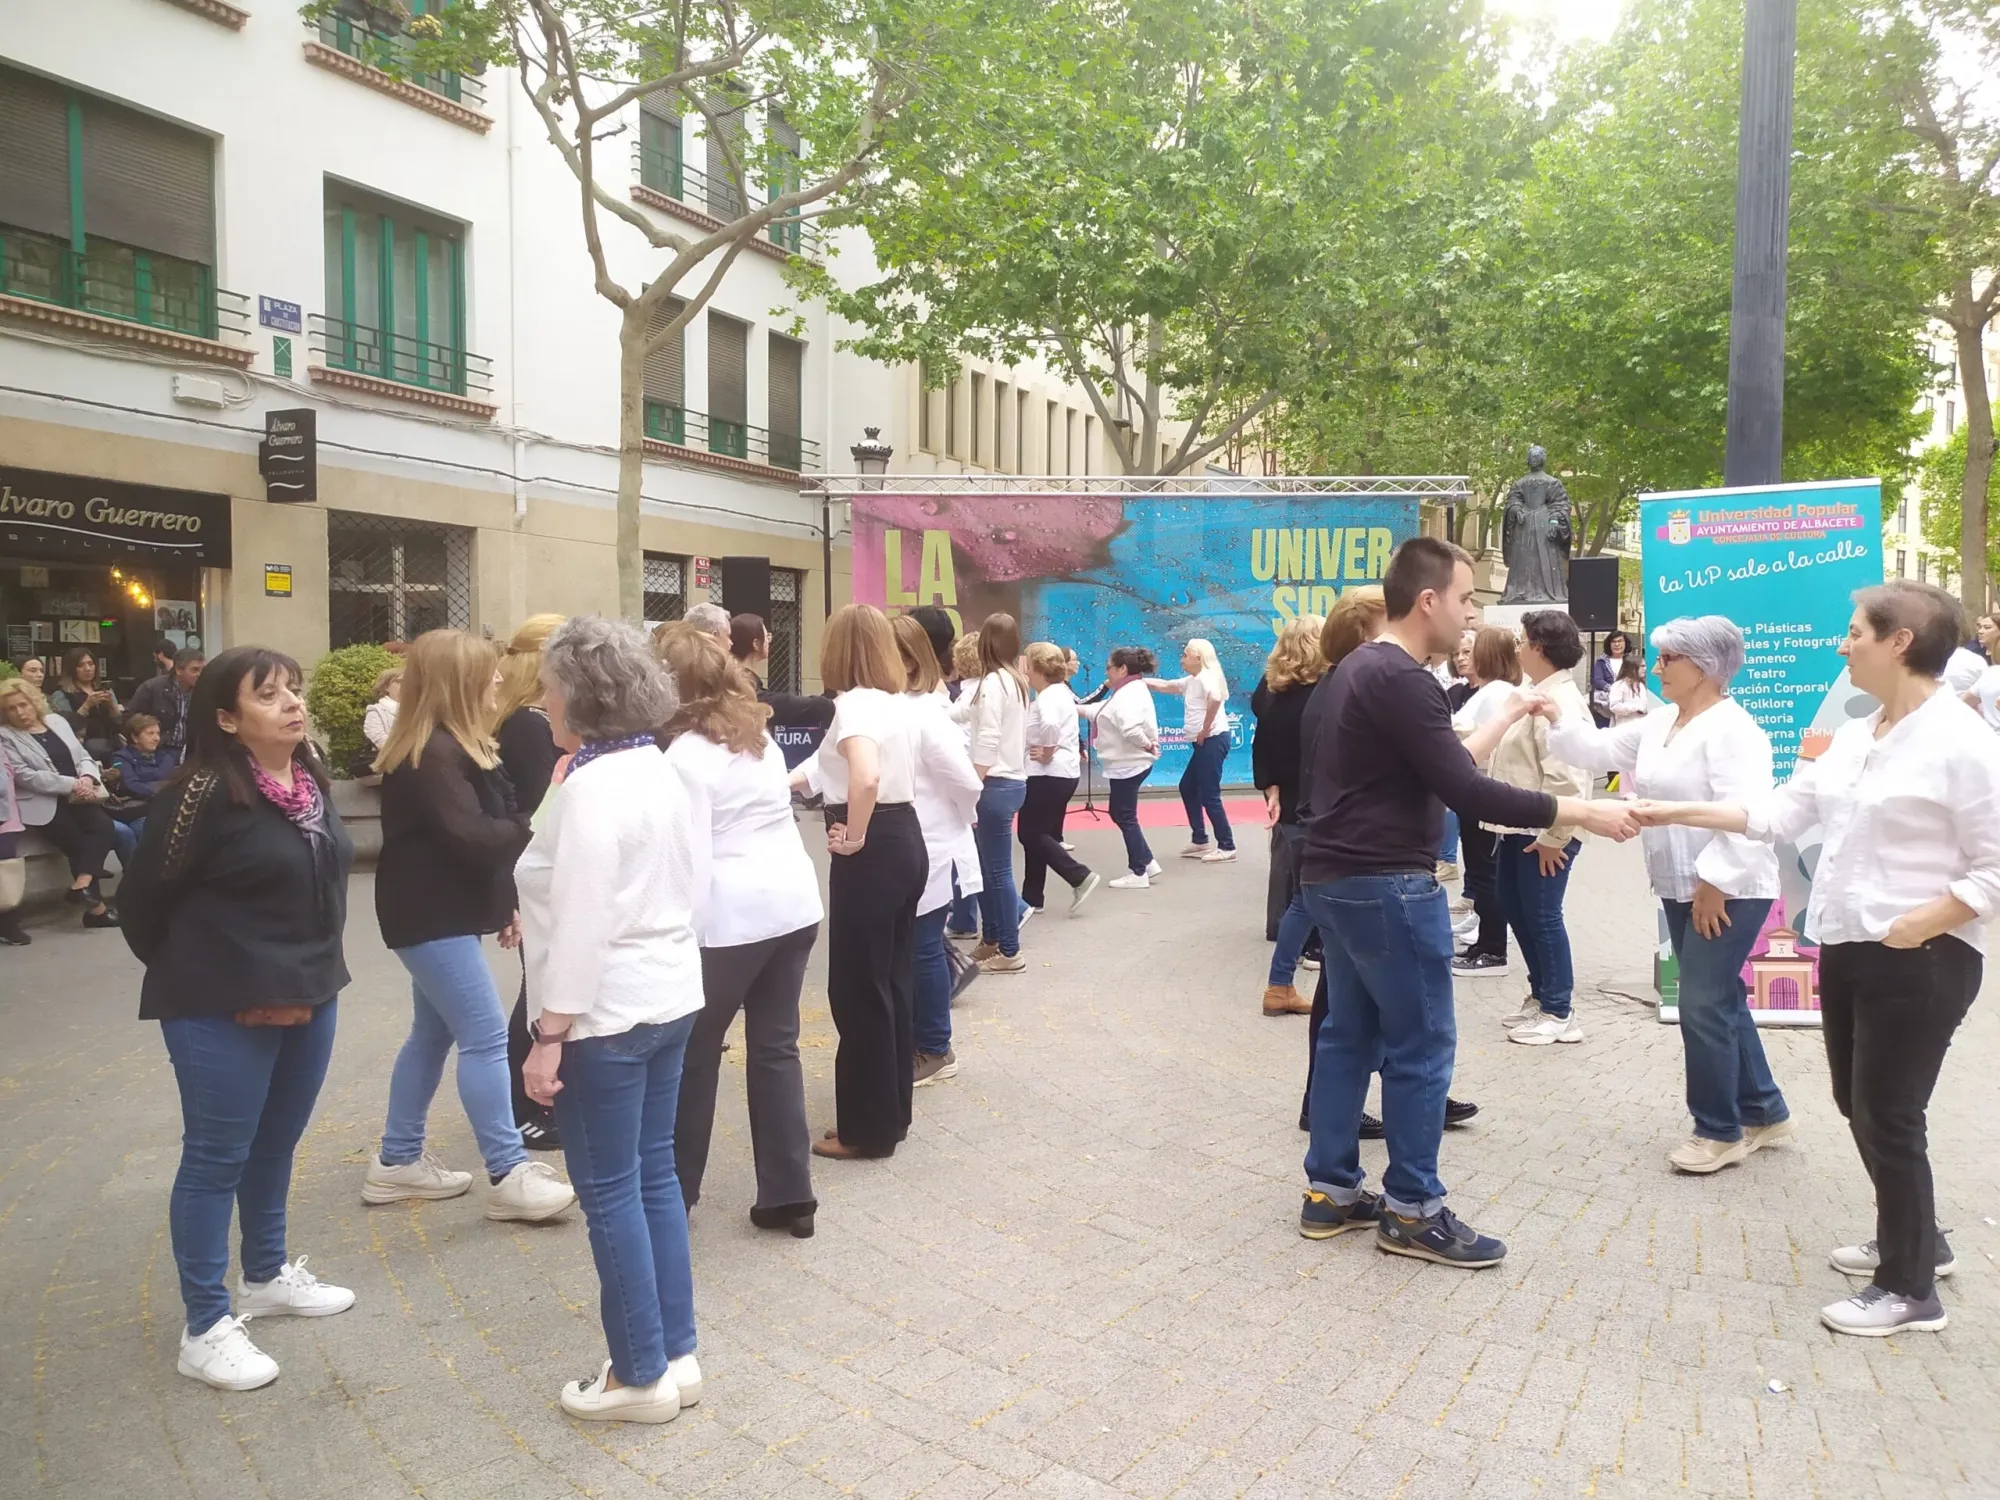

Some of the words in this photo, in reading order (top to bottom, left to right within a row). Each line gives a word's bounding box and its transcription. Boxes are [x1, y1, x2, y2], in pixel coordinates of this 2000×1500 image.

[273, 301, 298, 313] PLAZA
[0, 486, 75, 519] lvaro
[85, 497, 202, 533] Guerrero
[1698, 504, 1792, 523] Universidad
[1796, 501, 1858, 519] Popular
[1696, 521, 1780, 536] AYUNTAMIENTO
[1783, 520, 1797, 530] DE
[1800, 517, 1857, 529] ALBACETE
[1770, 532, 1782, 540] DE
[1783, 530, 1827, 540] CULTURA
[9, 533, 204, 557] STILISTAS
[1251, 527, 1393, 581] UNIVER
[885, 530, 957, 606] LA
[1658, 575, 1684, 594] la
[1684, 565, 1722, 588] UP
[1726, 558, 1770, 581] sale
[1771, 563, 1787, 573] a
[1787, 550, 1814, 569] la
[1815, 540, 1868, 564] calle
[1739, 625, 1752, 635] es
[1755, 621, 1812, 634] Plásticas
[1743, 638, 1770, 650] ales
[1773, 640, 1781, 651] y
[1743, 653, 1796, 665] lamenco
[1747, 668, 1786, 680] Teatro
[1774, 680, 1830, 696] Corporal
[1743, 698, 1794, 710] Folklore
[1766, 730, 1795, 738] erna
[1772, 743, 1805, 754] aleza
